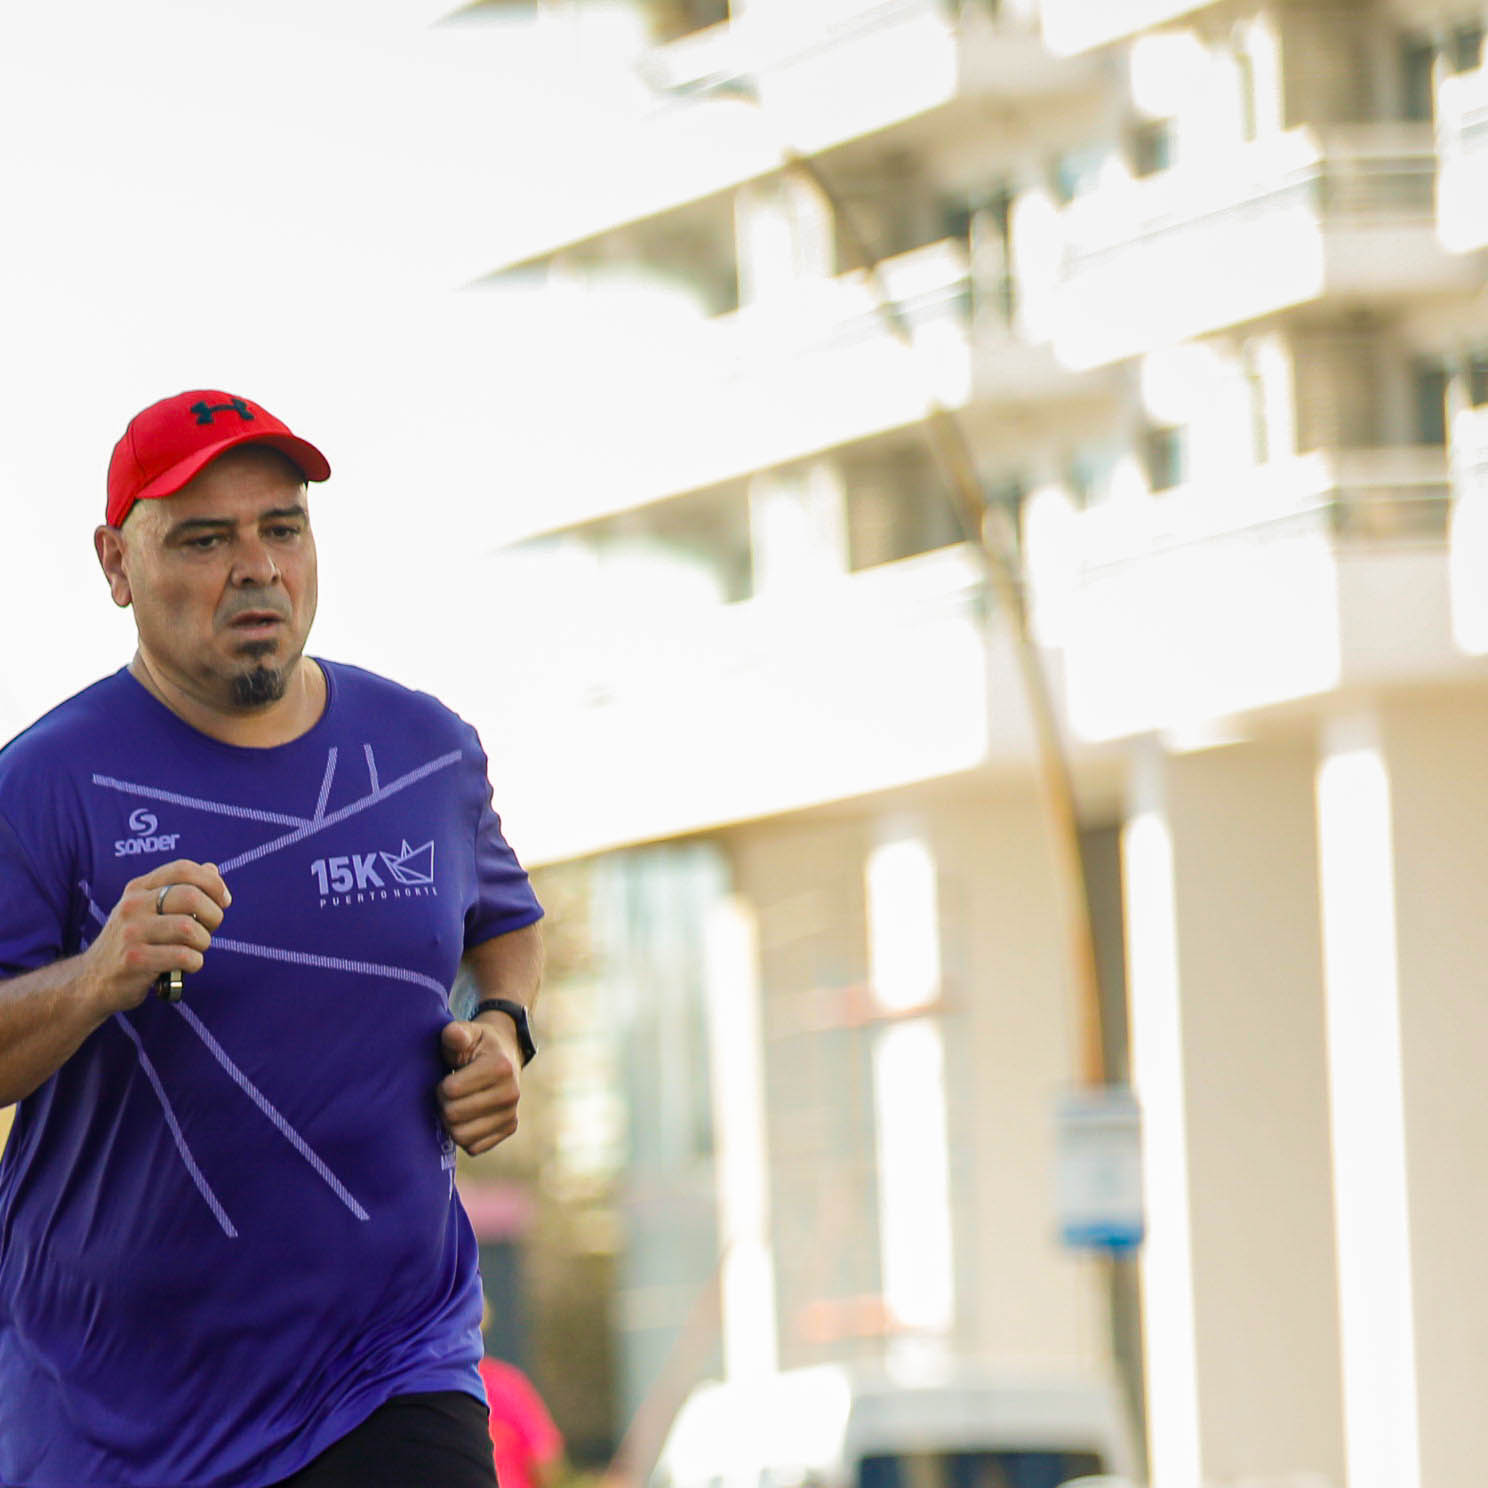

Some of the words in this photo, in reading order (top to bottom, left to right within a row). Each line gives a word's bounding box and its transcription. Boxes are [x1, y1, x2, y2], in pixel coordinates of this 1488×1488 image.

[311, 853, 384, 895] 15K
[320, 890, 387, 909] PUERTO
[393, 886, 438, 898] NORTE
